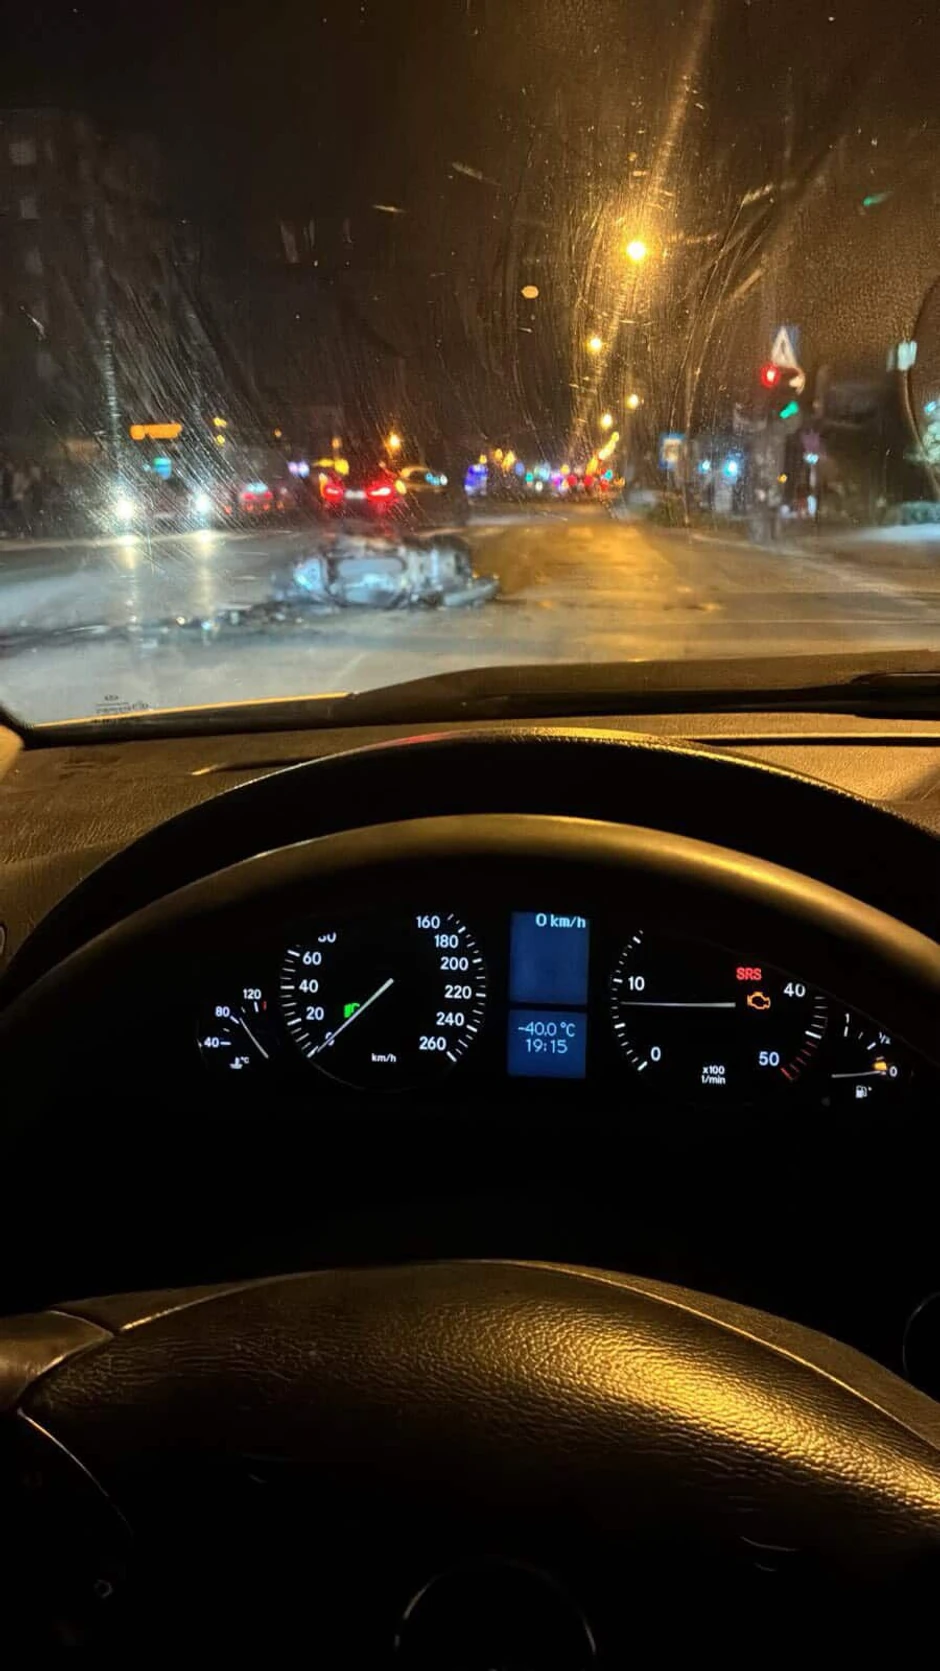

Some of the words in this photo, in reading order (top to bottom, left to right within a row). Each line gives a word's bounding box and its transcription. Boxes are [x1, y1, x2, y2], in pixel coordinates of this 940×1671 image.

[417, 916, 440, 929] 160
[536, 913, 547, 927] 0
[550, 914, 586, 928] km/h
[435, 934, 458, 948] 180
[303, 952, 321, 965] 60
[441, 957, 468, 970] 200
[736, 967, 762, 980] SRS
[299, 980, 318, 992] 40
[628, 976, 645, 991] 10
[784, 983, 805, 997] 40
[243, 988, 262, 1000] 120
[445, 985, 471, 999] 220
[215, 1006, 230, 1017] 80
[306, 1007, 324, 1020] 20
[437, 1012, 464, 1026] 240
[518, 1022, 557, 1036] -40.0
[204, 1037, 219, 1047] 40
[420, 1036, 446, 1050] 260
[526, 1039, 567, 1053] 19:15
[372, 1054, 396, 1062] km/h
[651, 1047, 661, 1061] 0
[759, 1052, 779, 1066] 50
[703, 1066, 725, 1074] x100
[889, 1066, 898, 1077] 0
